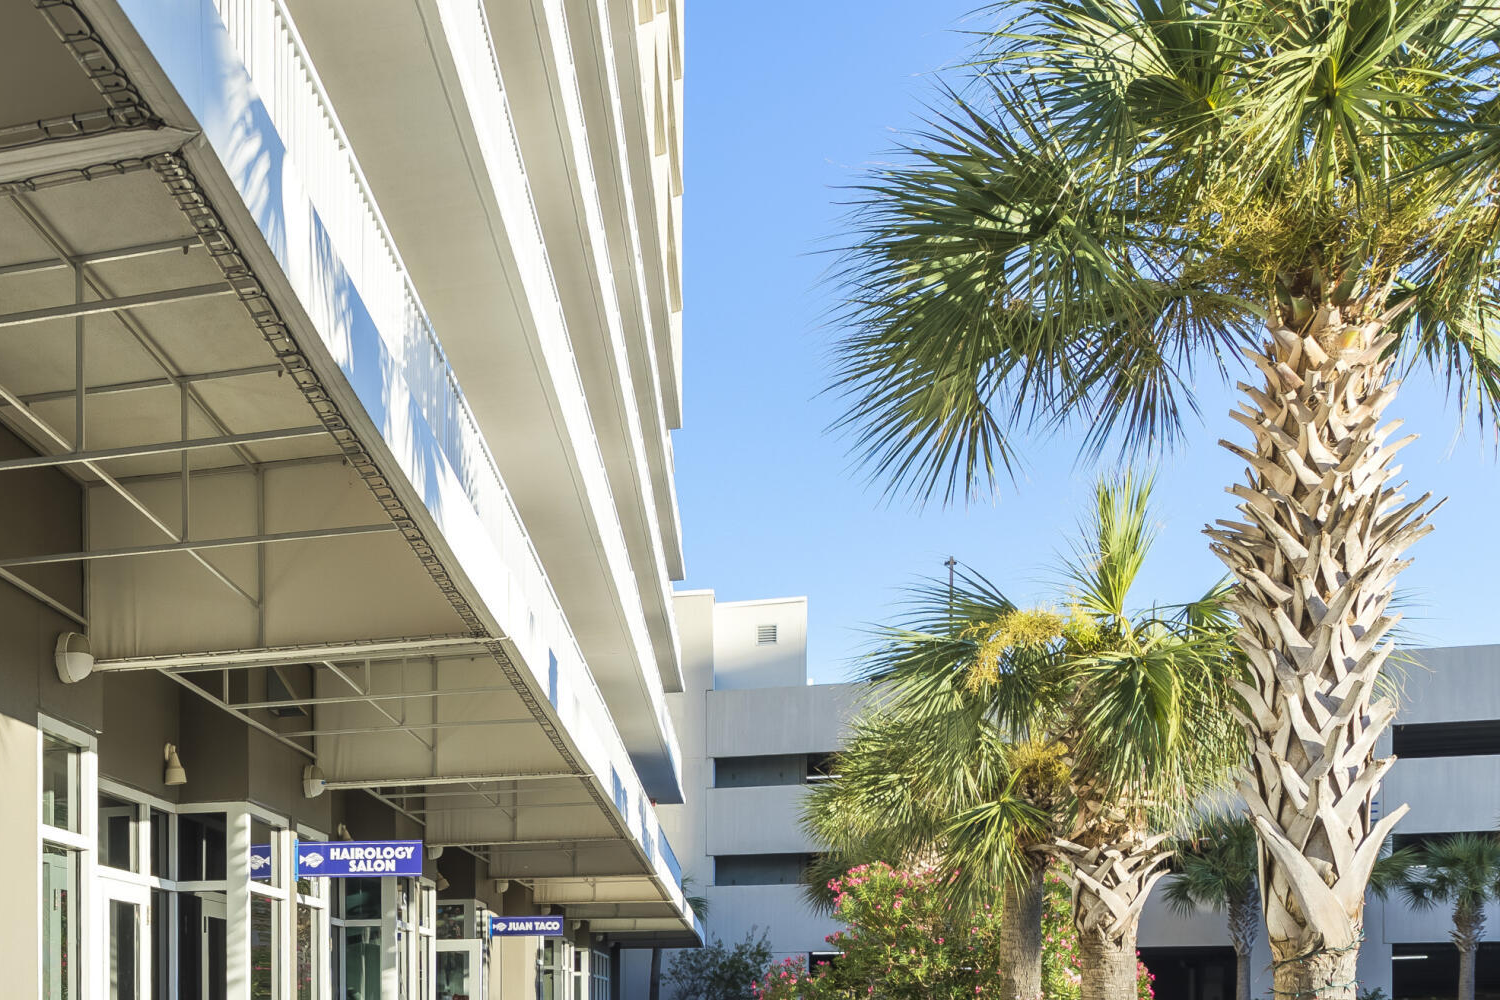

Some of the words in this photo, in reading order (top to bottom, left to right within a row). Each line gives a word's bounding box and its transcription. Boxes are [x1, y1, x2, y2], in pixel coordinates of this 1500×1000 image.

[330, 846, 415, 861] HAIROLOGY
[349, 859, 396, 872] SALON
[507, 921, 533, 932] JUAN
[534, 920, 560, 931] TACO
